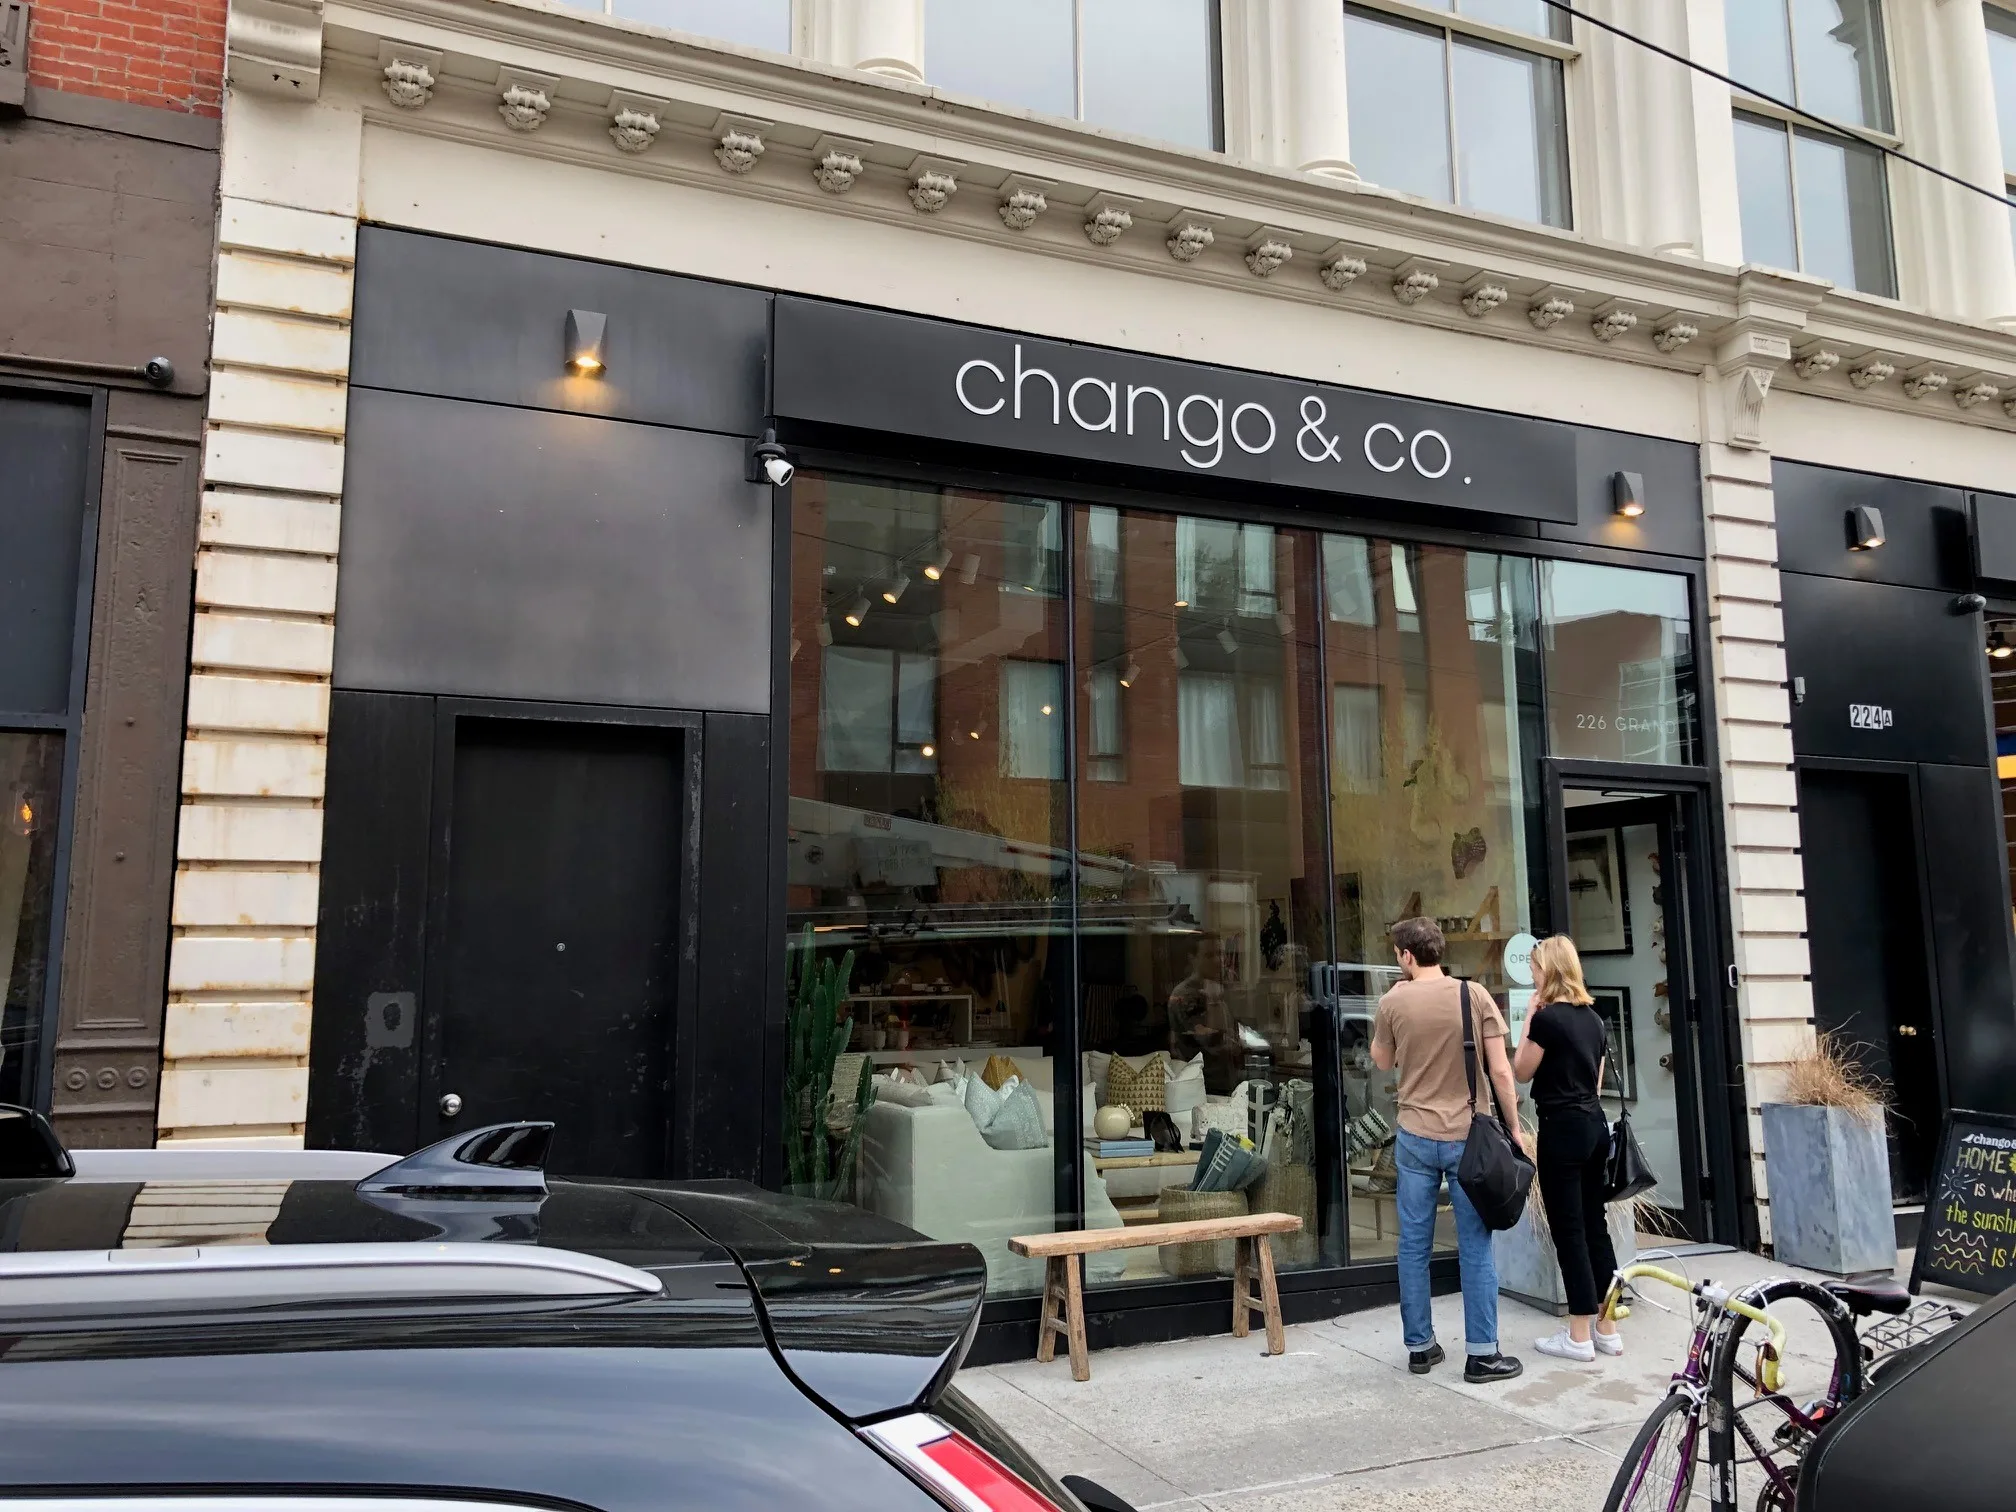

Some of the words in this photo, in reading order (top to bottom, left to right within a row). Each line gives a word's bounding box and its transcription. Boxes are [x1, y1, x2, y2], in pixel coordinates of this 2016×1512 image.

[955, 343, 1277, 469] chango
[1295, 394, 1343, 463] &
[1363, 421, 1473, 485] co.
[1576, 713, 1607, 730] 226
[1614, 716, 1676, 735] GRAND
[1851, 705, 1892, 728] 224A
[1509, 953, 1531, 964] OPE
[1956, 1146, 2010, 1175] HOME
[1946, 1200, 1968, 1225] the
